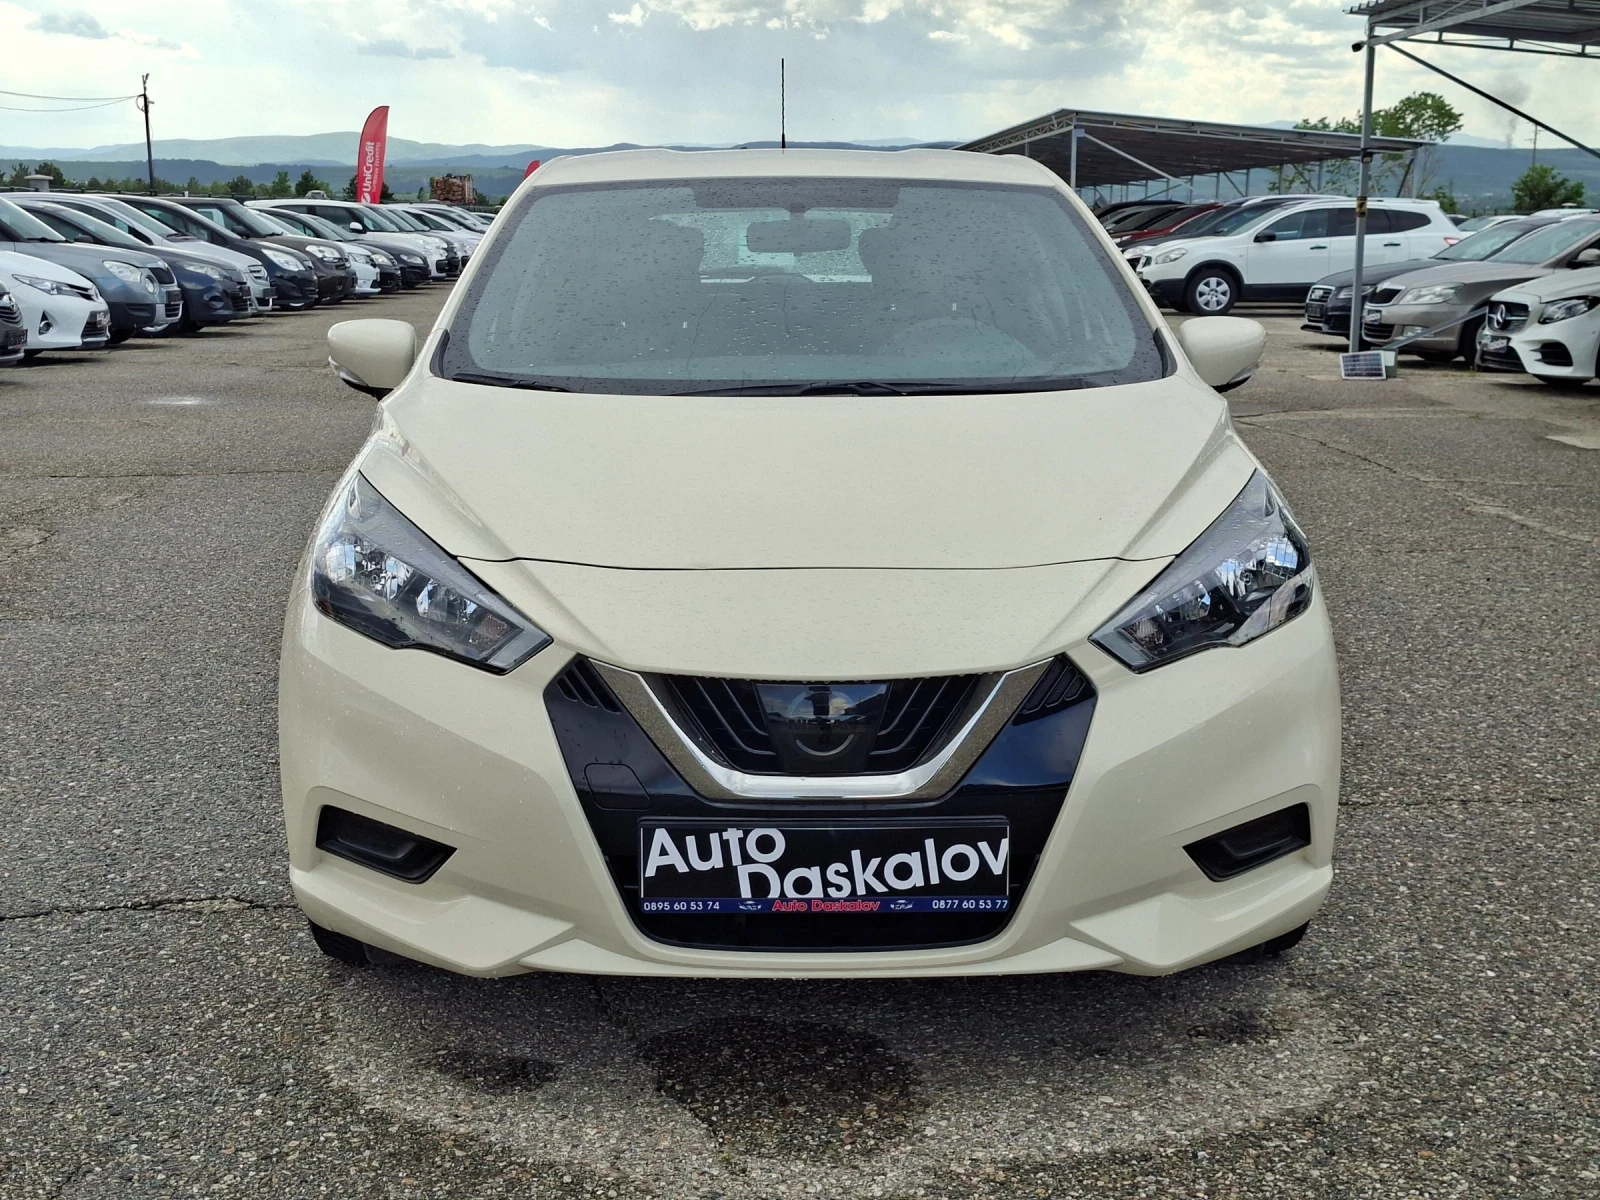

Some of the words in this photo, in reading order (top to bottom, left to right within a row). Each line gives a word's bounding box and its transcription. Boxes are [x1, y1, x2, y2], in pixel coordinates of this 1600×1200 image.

[362, 142, 375, 192] UniCredit
[644, 828, 786, 878] Auto
[737, 838, 1009, 899] Daskalov
[643, 901, 671, 911] 0895
[673, 901, 687, 911] 60
[690, 901, 704, 911] 53
[707, 901, 720, 911] 74
[772, 900, 808, 911] Auto
[811, 899, 880, 911] Daskalov
[932, 900, 959, 909] 0877
[962, 900, 976, 909] 60
[978, 900, 992, 909] 53
[995, 899, 1008, 909] 77
